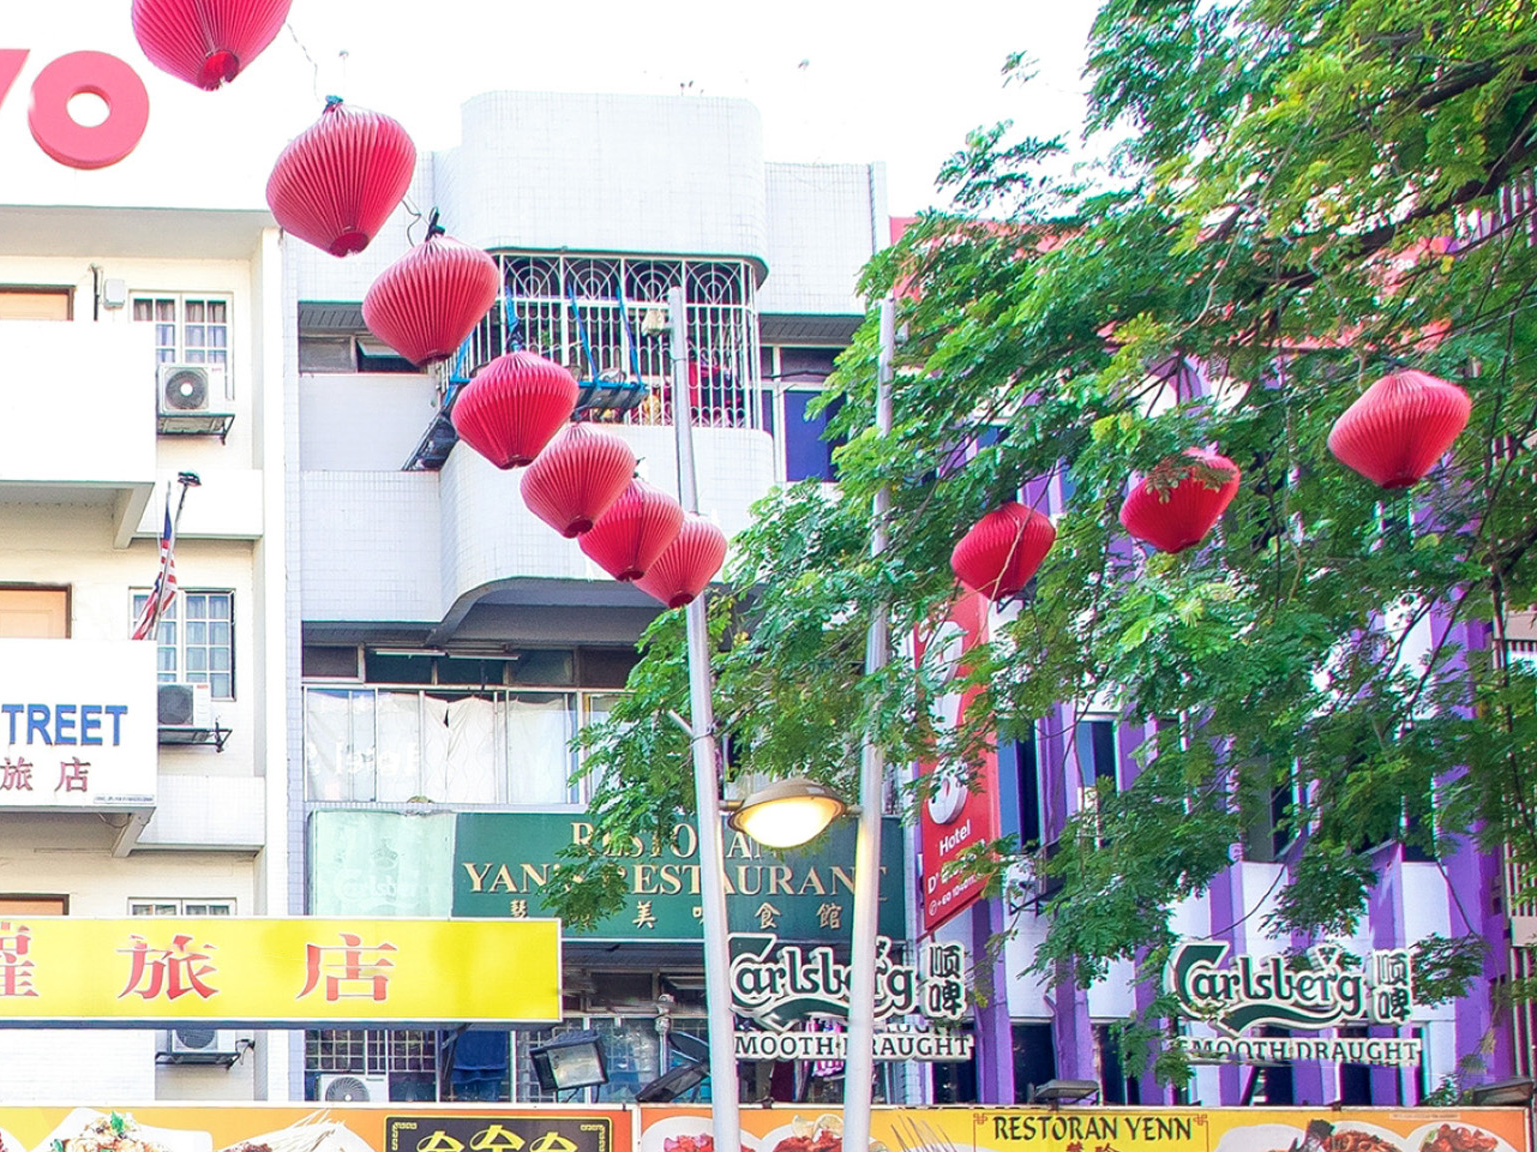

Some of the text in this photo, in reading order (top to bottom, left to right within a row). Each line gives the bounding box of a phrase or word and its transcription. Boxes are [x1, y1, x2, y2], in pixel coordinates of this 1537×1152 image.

[939, 819, 971, 857] Hotel
[929, 946, 962, 1016] 顺啤
[1175, 943, 1363, 1017] Carlsberg
[1376, 951, 1411, 1021] 顺啤
[735, 1036, 970, 1057] MOOTH RAUGHT
[1298, 1041, 1416, 1061] DRAUGHT
[993, 1116, 1193, 1141] RESTORAN YENN
